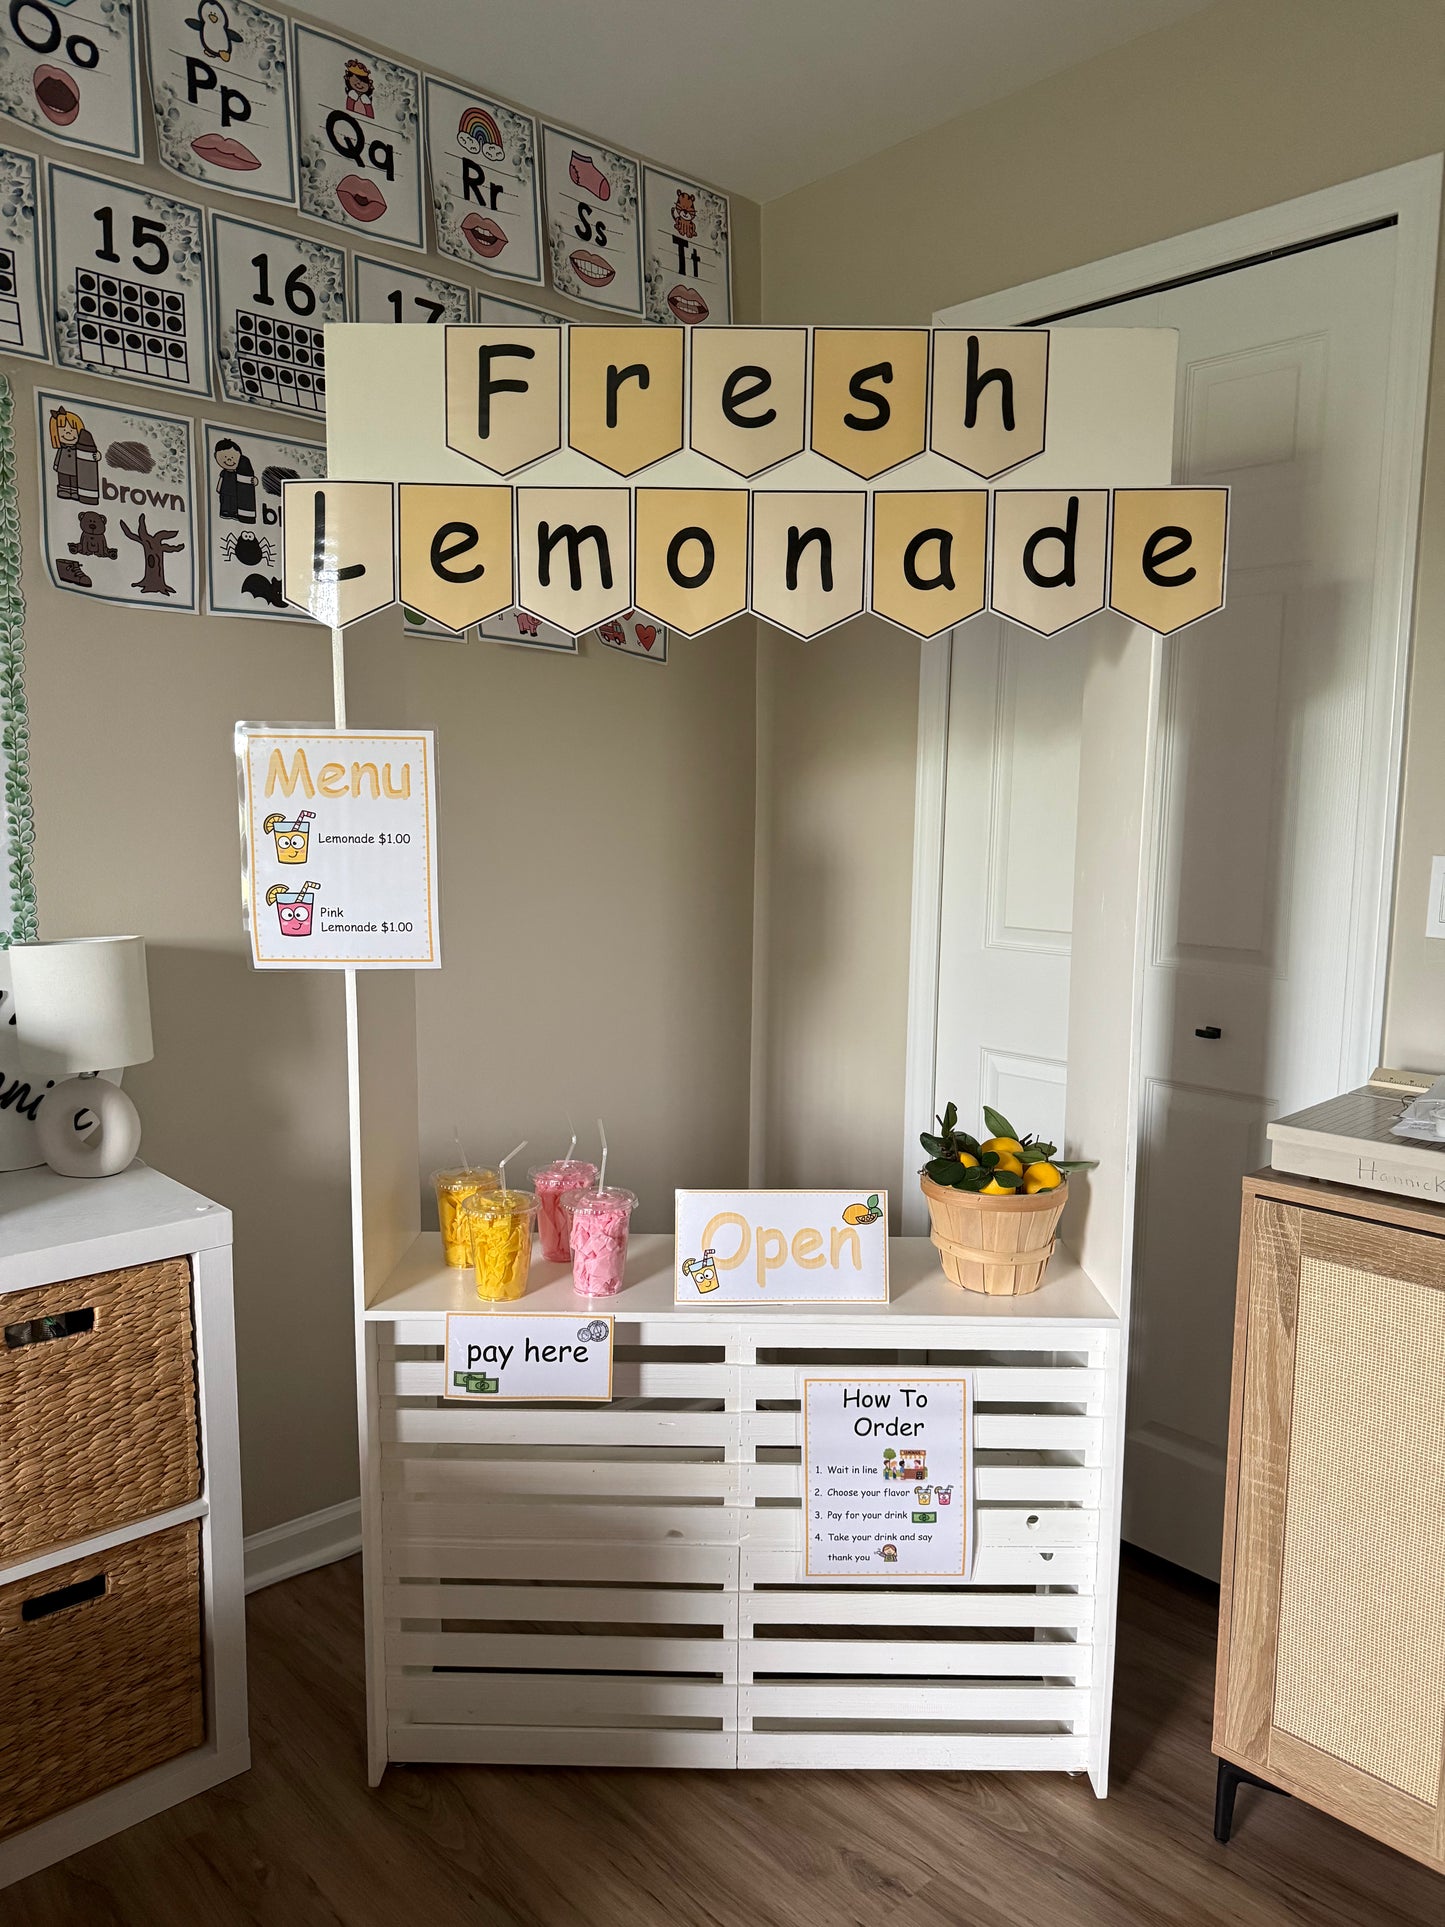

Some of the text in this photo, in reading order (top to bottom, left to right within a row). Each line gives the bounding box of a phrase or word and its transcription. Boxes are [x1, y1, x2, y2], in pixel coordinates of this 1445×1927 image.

[9, 0, 100, 69] Oo
[186, 56, 252, 127] Pp
[325, 109, 395, 182] Qq
[461, 156, 504, 211] Rr
[93, 206, 170, 275] 15
[574, 201, 608, 248] Ss
[671, 234, 700, 278] Tt
[251, 253, 317, 317] 16
[478, 335, 1016, 440] Fresh
[101, 477, 186, 513] brown
[313, 490, 1198, 592] Lemonade
[264, 748, 411, 800] Menu
[318, 832, 411, 845] Lemonade $1.00
[320, 907, 345, 919] Pink
[321, 921, 414, 935] Lemonade $1.00
[701, 1211, 862, 1289] Open
[467, 1337, 589, 1371] pay here
[843, 1388, 928, 1409] How To
[854, 1416, 926, 1437] Order
[815, 1465, 878, 1475] 1. Wait in line
[814, 1487, 910, 1499] 2. Choose your flavor
[814, 1510, 908, 1522] 3. Pay for your drink
[814, 1532, 933, 1543] 4. Take your drink and say
[827, 1553, 871, 1563] thank you
